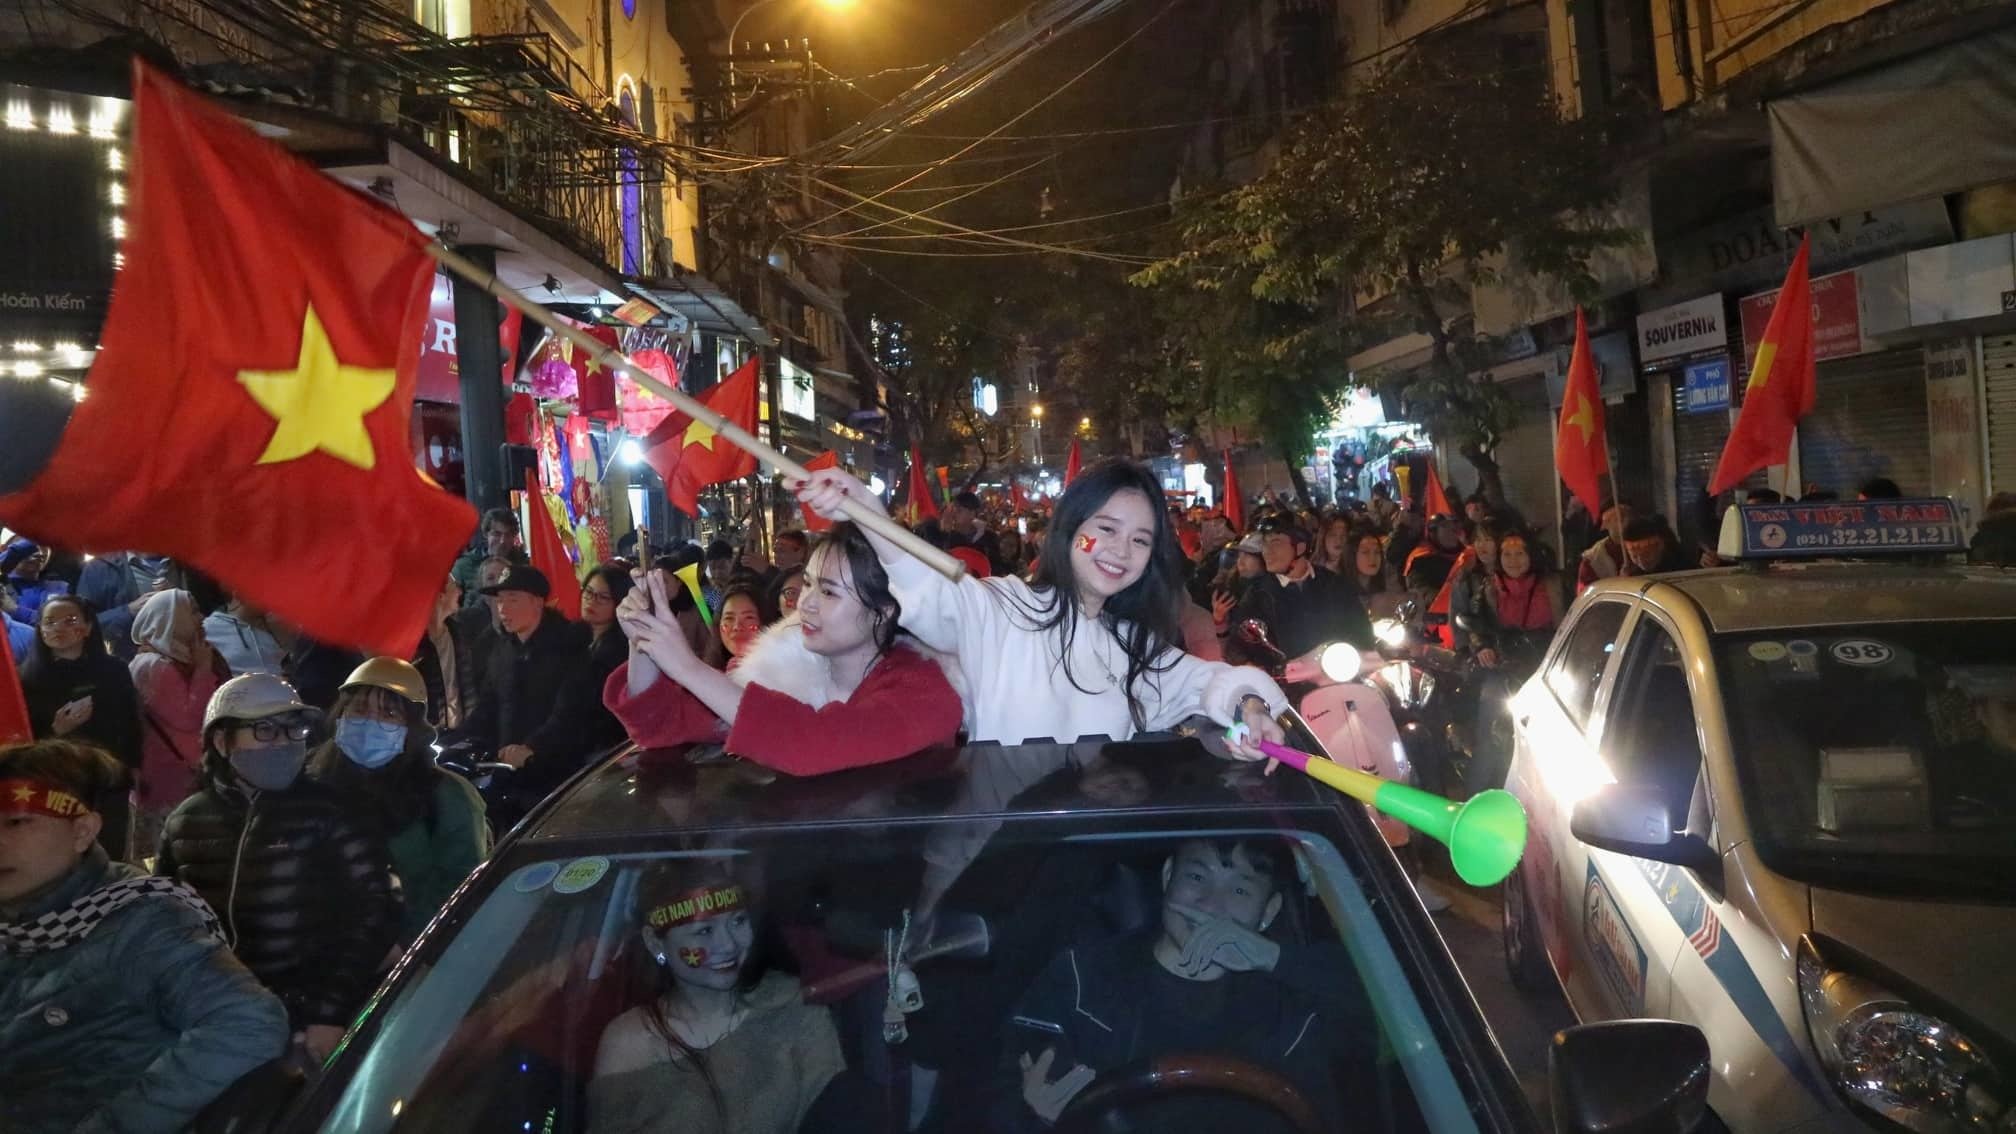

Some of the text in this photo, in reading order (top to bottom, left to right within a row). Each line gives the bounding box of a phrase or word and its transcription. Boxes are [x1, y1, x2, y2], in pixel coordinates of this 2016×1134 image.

[2005, 294, 2016, 309] 2
[1796, 526, 1950, 546] (024) 32.21.21.21
[1840, 643, 1884, 660] 98
[668, 898, 696, 921] NAM
